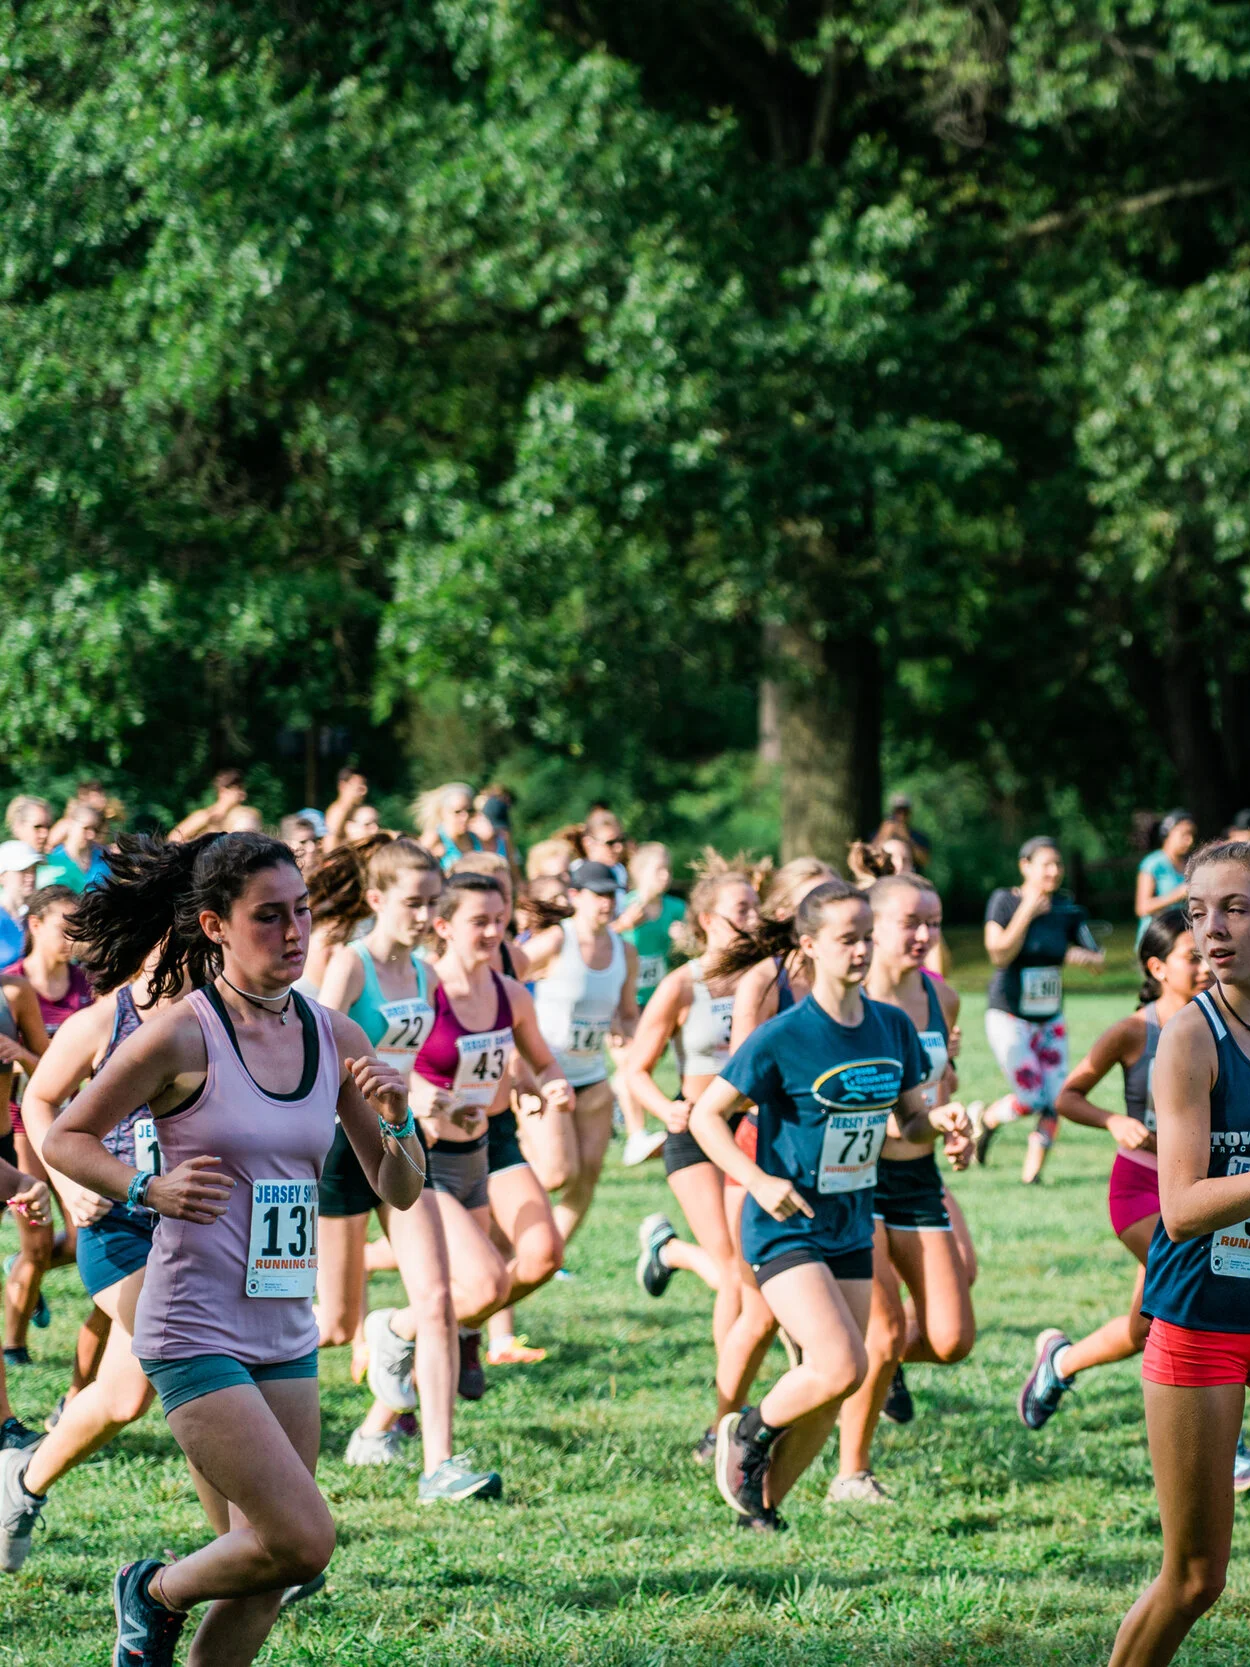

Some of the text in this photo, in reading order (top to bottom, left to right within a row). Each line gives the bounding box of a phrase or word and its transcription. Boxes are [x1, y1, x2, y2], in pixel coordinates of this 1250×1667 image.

[390, 1016, 423, 1047] 72
[473, 1049, 504, 1080] 43
[838, 1129, 873, 1164] 73
[255, 1185, 301, 1203] JERSEY
[255, 1259, 306, 1270] RUNNING
